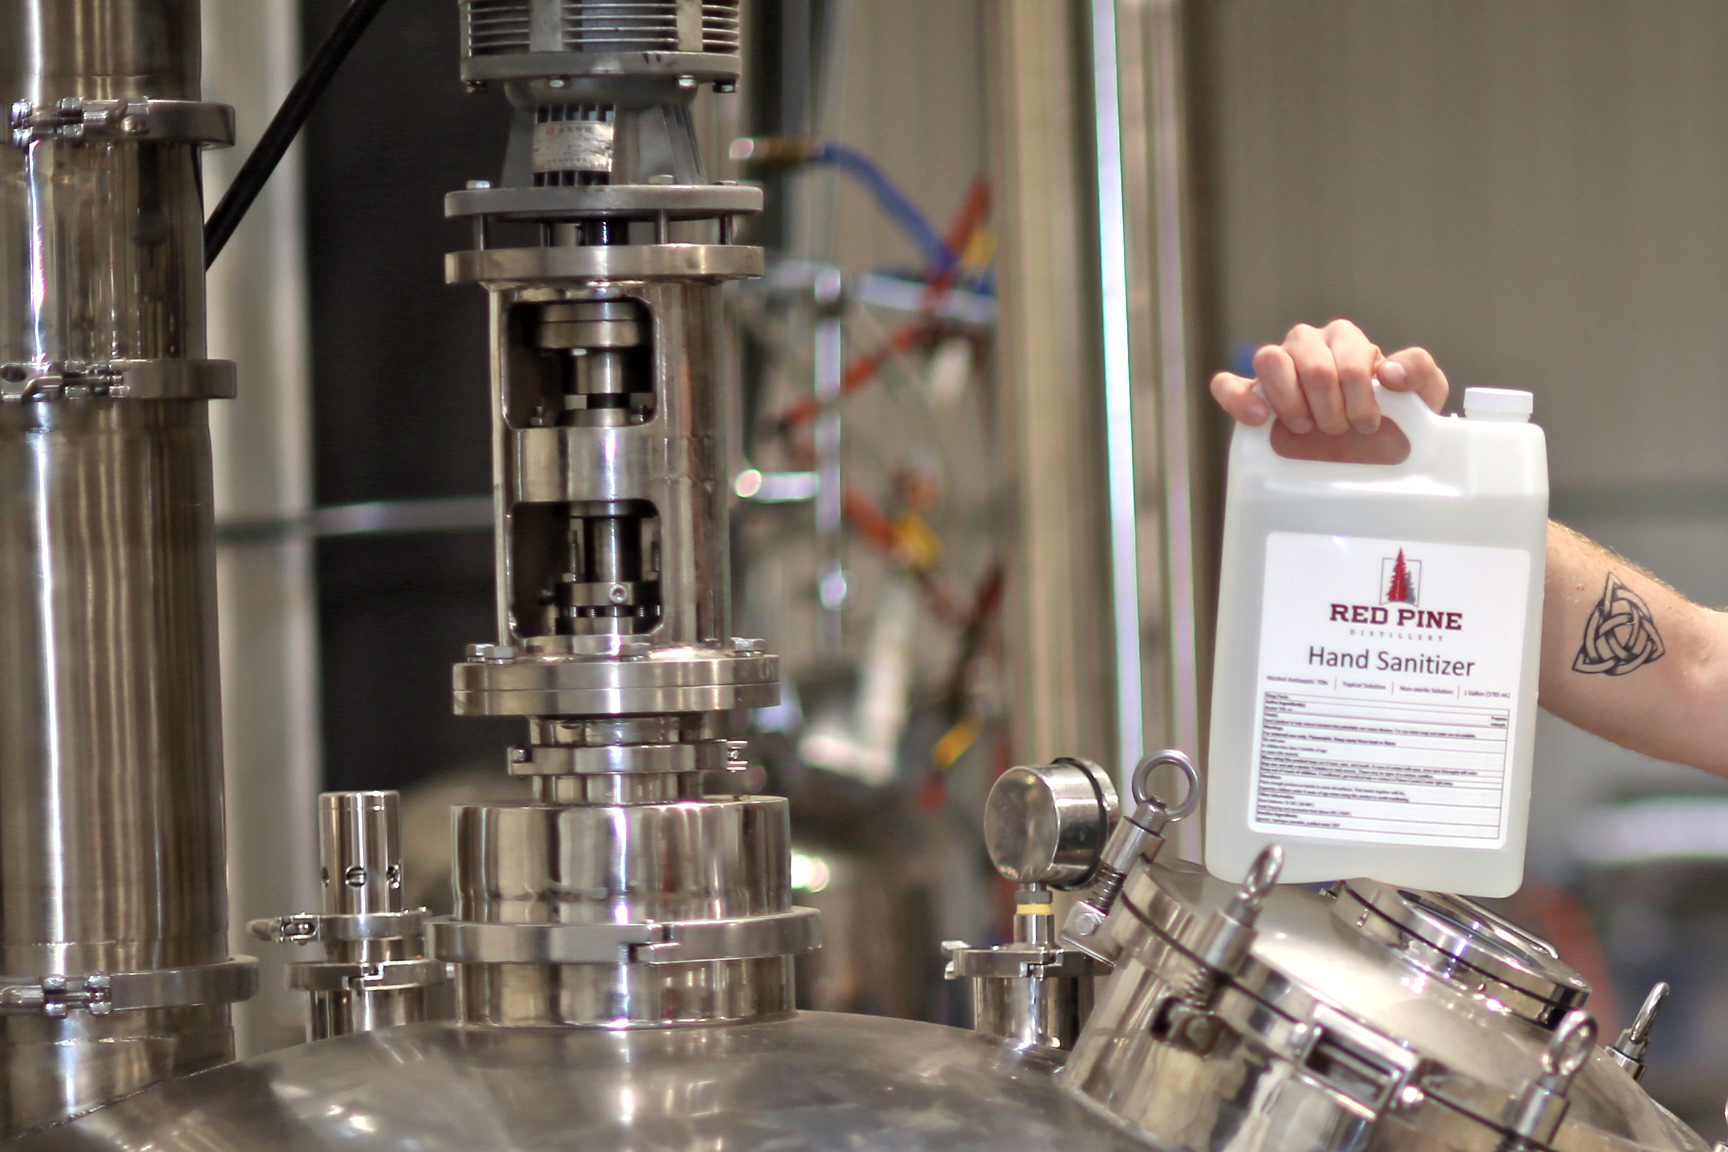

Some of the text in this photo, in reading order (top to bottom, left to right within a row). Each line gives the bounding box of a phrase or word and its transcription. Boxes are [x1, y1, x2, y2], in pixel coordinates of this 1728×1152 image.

[1329, 603, 1463, 631] RED PINE
[1350, 629, 1443, 642] DISTILLERY
[1309, 645, 1475, 677] Hand Sanitizer
[1363, 682, 1387, 690] Solution
[1431, 687, 1454, 695] Solution
[1468, 689, 1485, 697] Gallon
